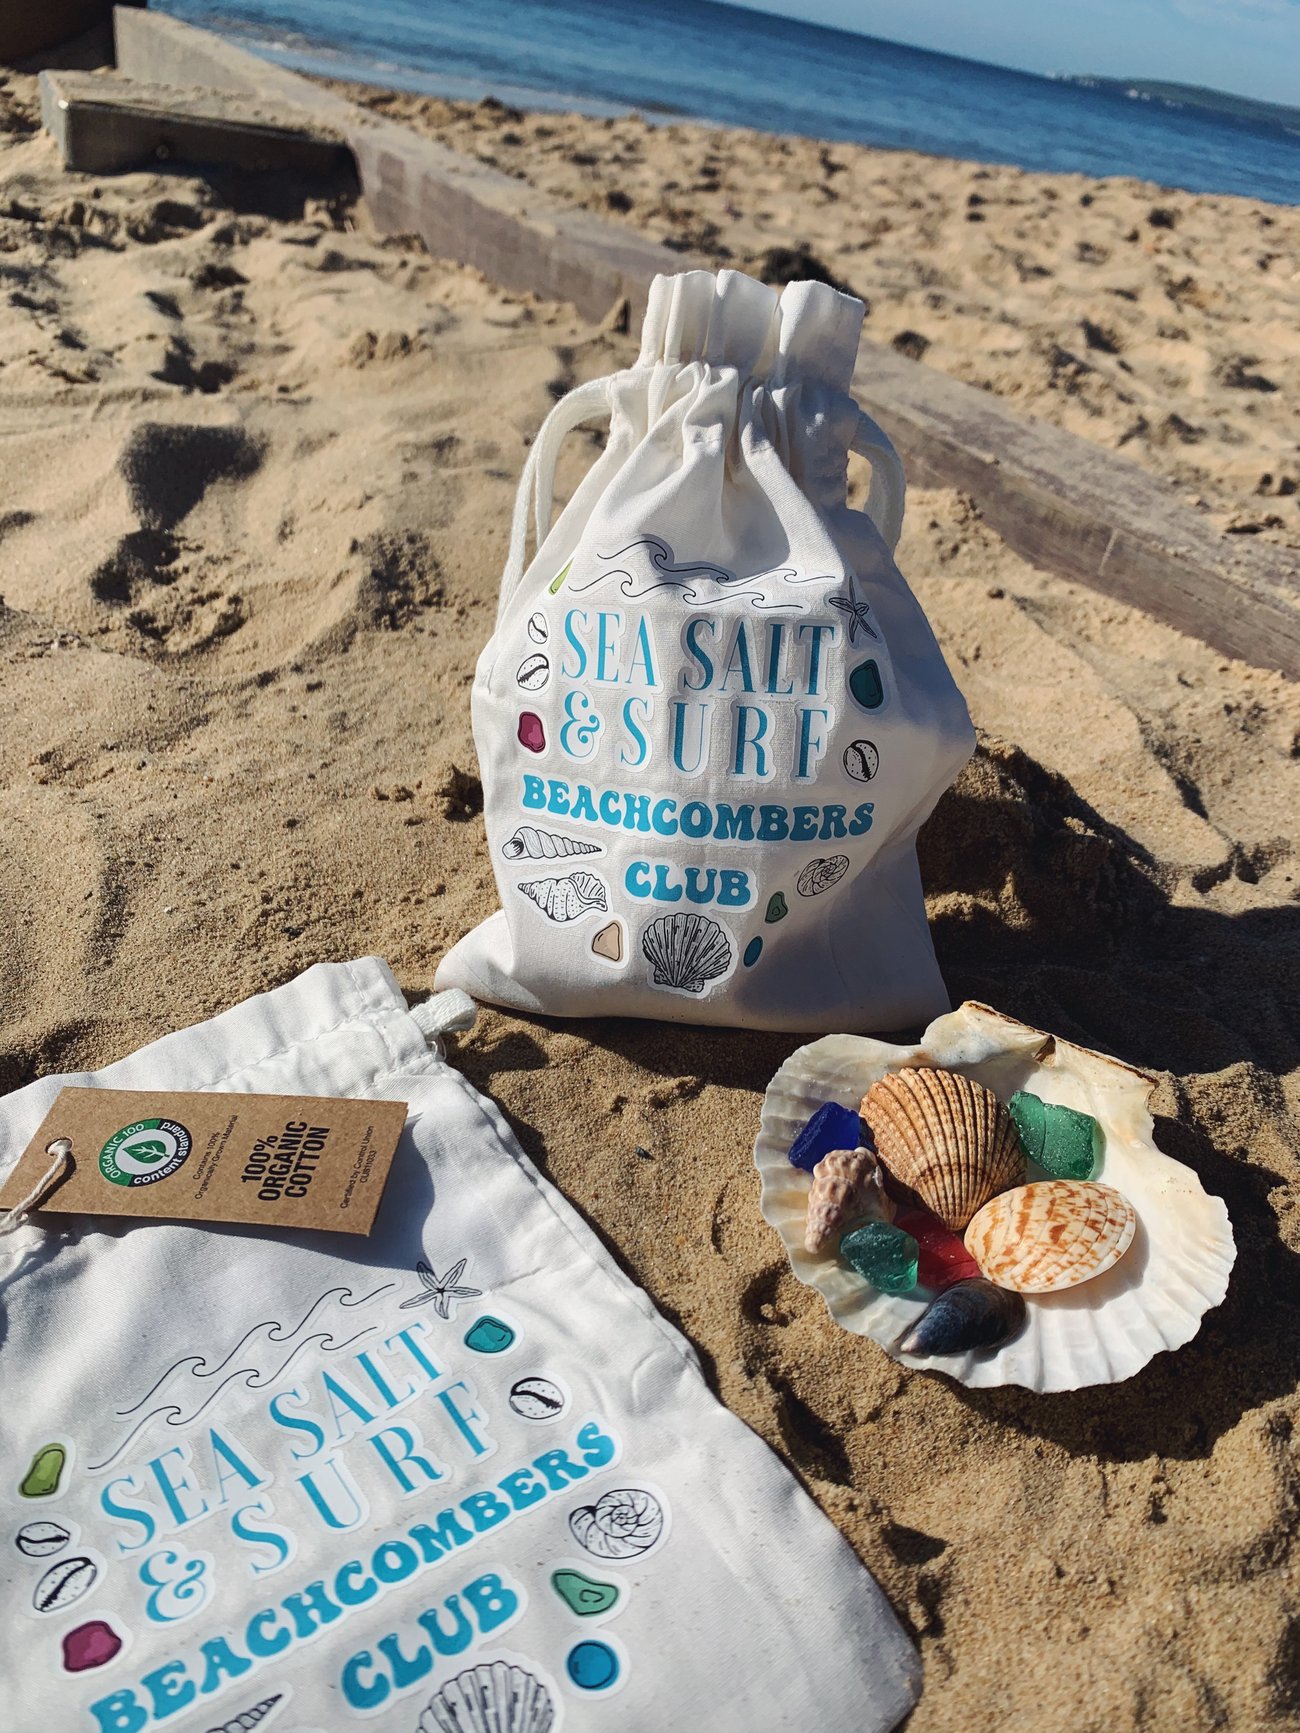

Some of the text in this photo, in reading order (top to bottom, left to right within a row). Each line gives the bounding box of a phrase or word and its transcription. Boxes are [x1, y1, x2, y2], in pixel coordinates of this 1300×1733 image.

[561, 608, 835, 696] SEA SALT
[560, 690, 828, 778] & SURF
[522, 774, 875, 841] BEACHCOMBERS
[625, 861, 751, 905] CLUB
[102, 1123, 144, 1178] ORGANIC 100
[133, 1121, 189, 1184] content standard
[193, 1132, 220, 1180] Contains 100%
[194, 1114, 239, 1199] Organically Grown Material
[241, 1135, 279, 1183] 100%
[258, 1121, 308, 1201] ORGANIC
[284, 1126, 331, 1198] COTTON
[340, 1125, 375, 1209] Certified by Control Union
[100, 1321, 444, 1553] SEA SALT
[139, 1380, 491, 1623] & SURF
[88, 1421, 616, 1733] BEACHCOMBERS
[340, 1573, 519, 1710] CLUB
